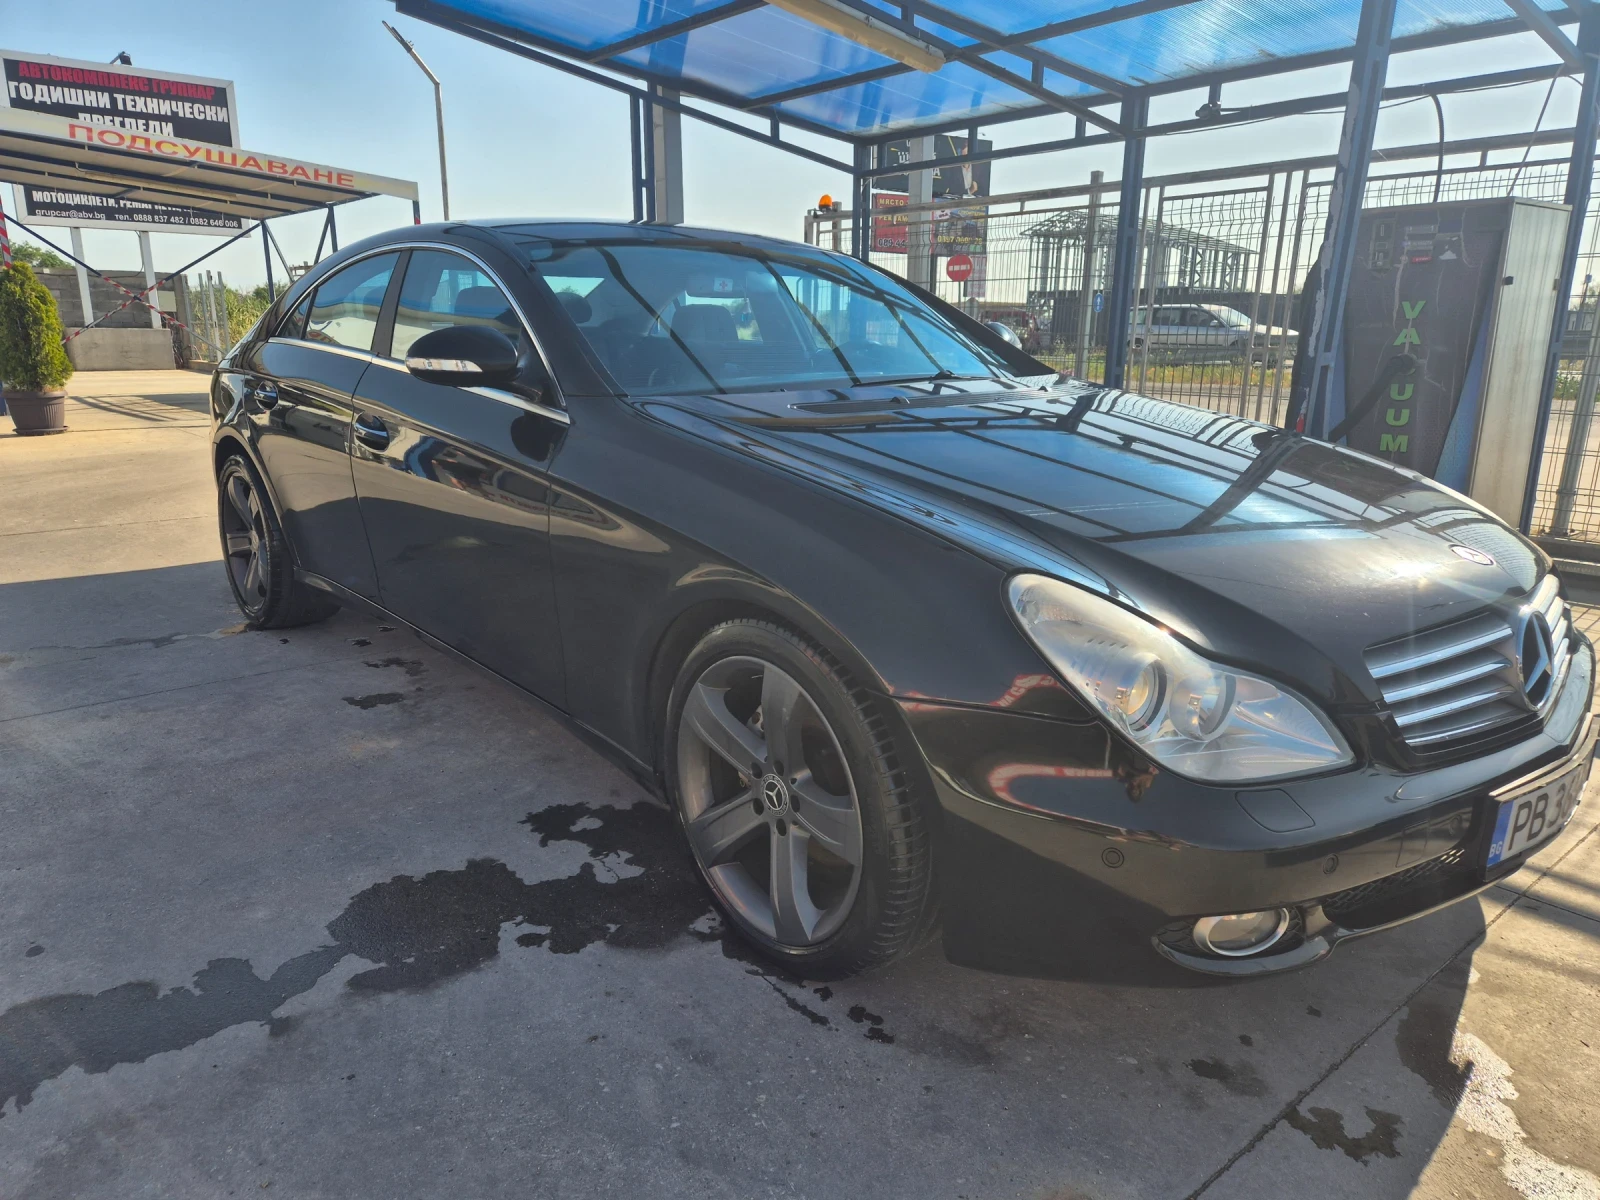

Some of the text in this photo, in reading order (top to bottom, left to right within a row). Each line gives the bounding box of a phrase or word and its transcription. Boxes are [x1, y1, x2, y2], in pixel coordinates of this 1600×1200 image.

[19, 61, 215, 100] АВТОКОМПЛЕКС ГРУПКАР
[8, 81, 229, 123] ГОДИШНИ ТЕХНИЧЕСКИ
[68, 123, 354, 188] ПОДСУШАВАНЕ
[35, 209, 106, 220] grupcar@abv.bg
[115, 213, 131, 221] тел.
[154, 215, 167, 223] 837
[170, 216, 184, 224] 482
[1380, 301, 1426, 452] VAUUM
[1489, 841, 1503, 857] BG
